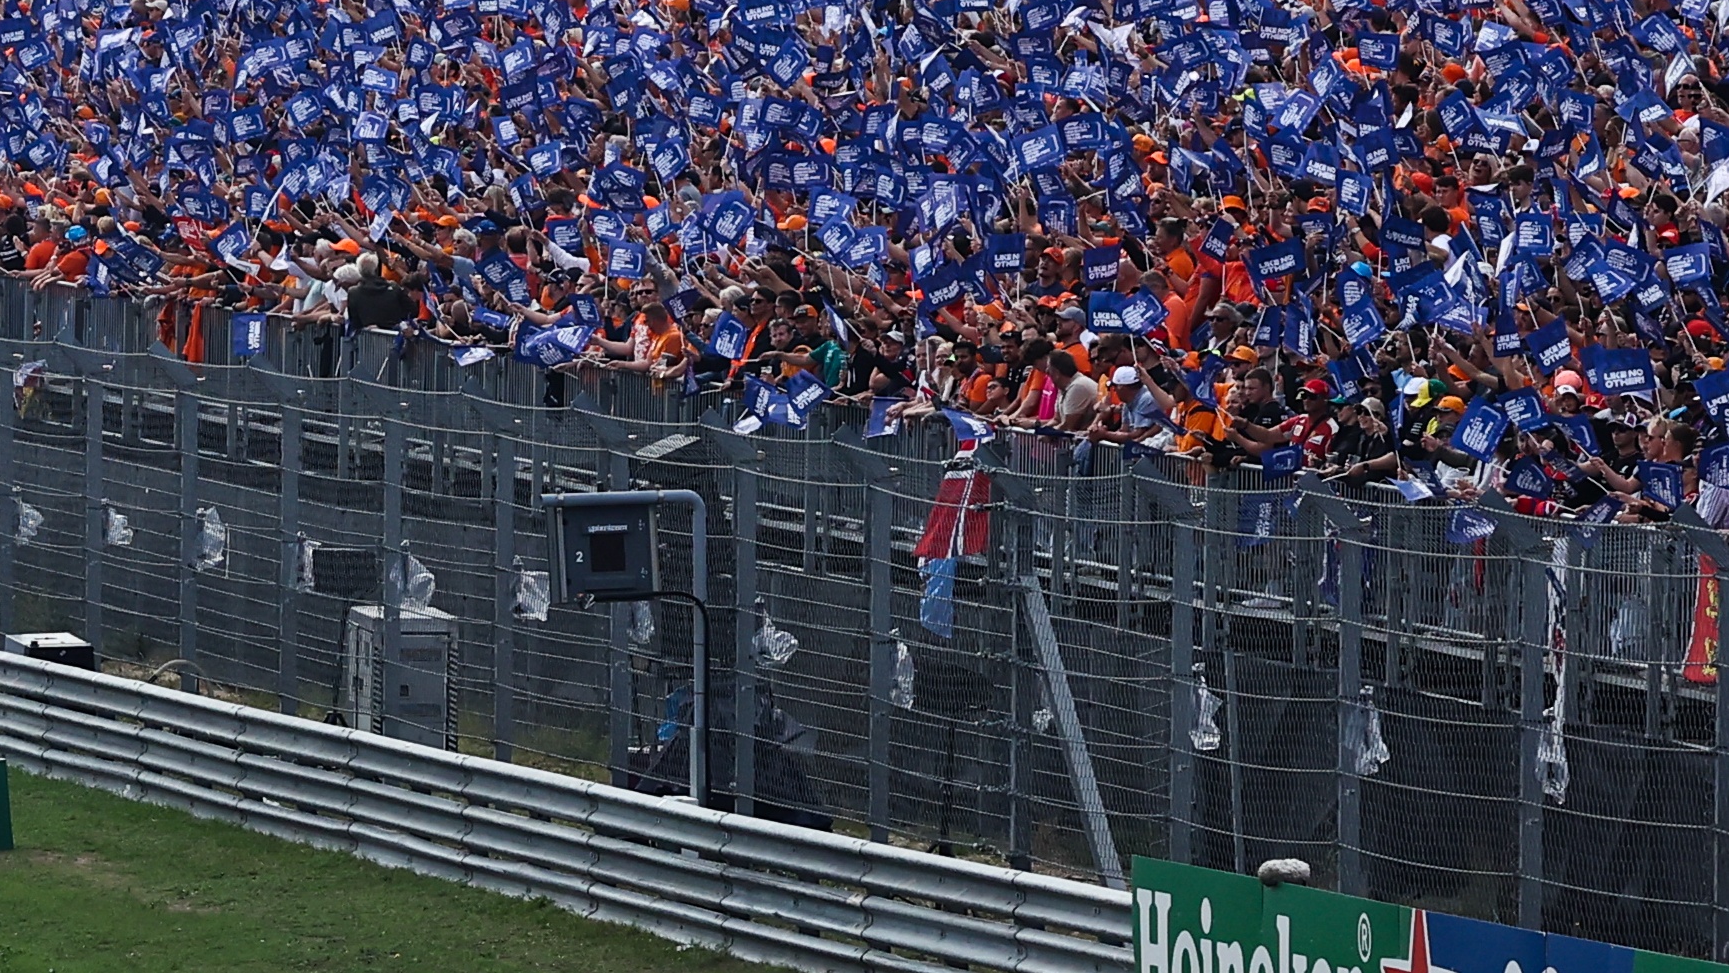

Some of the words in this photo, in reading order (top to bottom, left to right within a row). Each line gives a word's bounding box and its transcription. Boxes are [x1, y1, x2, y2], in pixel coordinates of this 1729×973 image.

[1604, 370, 1626, 380] LIKE
[1605, 377, 1645, 388] OTHER!
[576, 551, 583, 562] 2
